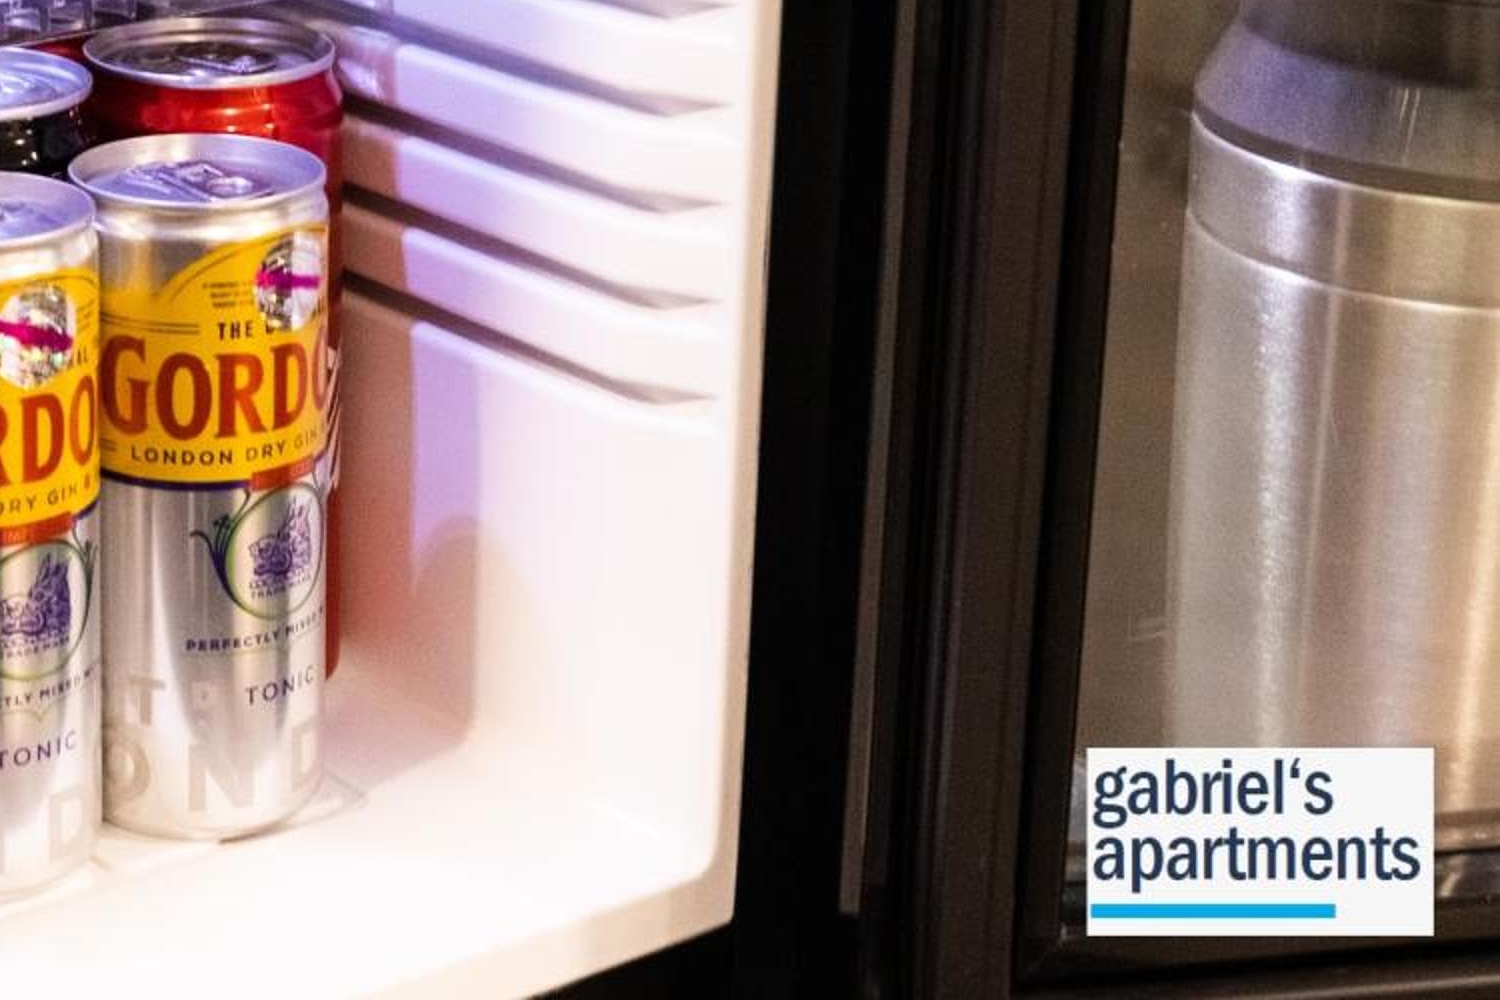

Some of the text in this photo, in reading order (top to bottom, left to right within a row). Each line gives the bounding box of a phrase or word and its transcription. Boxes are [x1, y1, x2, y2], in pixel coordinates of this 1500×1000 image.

[218, 321, 253, 340] THE
[131, 428, 316, 466] LONDON DRY GIN
[47, 485, 78, 506] GIN
[186, 629, 280, 651] PERFECTLY
[245, 665, 316, 706] TONIC
